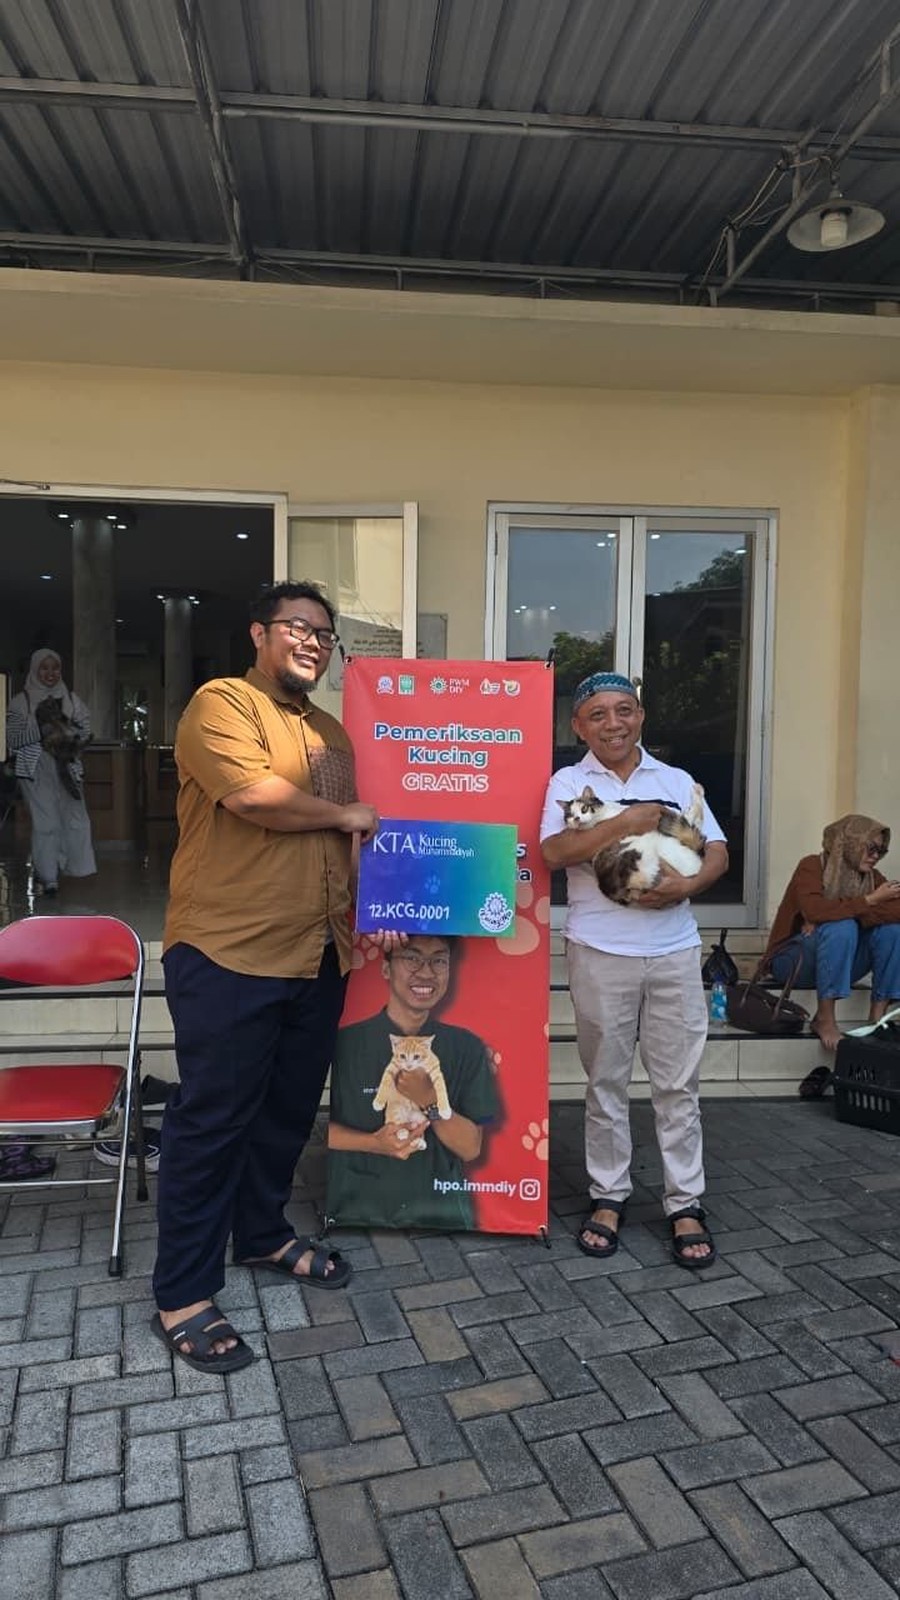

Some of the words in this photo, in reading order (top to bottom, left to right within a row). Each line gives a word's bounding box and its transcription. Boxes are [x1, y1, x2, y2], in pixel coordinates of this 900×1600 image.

[374, 722, 523, 744] Pemeriksaan
[408, 746, 489, 768] Kucing
[402, 772, 489, 792] GRATIS
[373, 832, 416, 854] KTA
[419, 834, 457, 850] Kucing
[369, 903, 450, 920] 12.KCG.0001
[433, 1178, 516, 1197] hpo.immdiy
